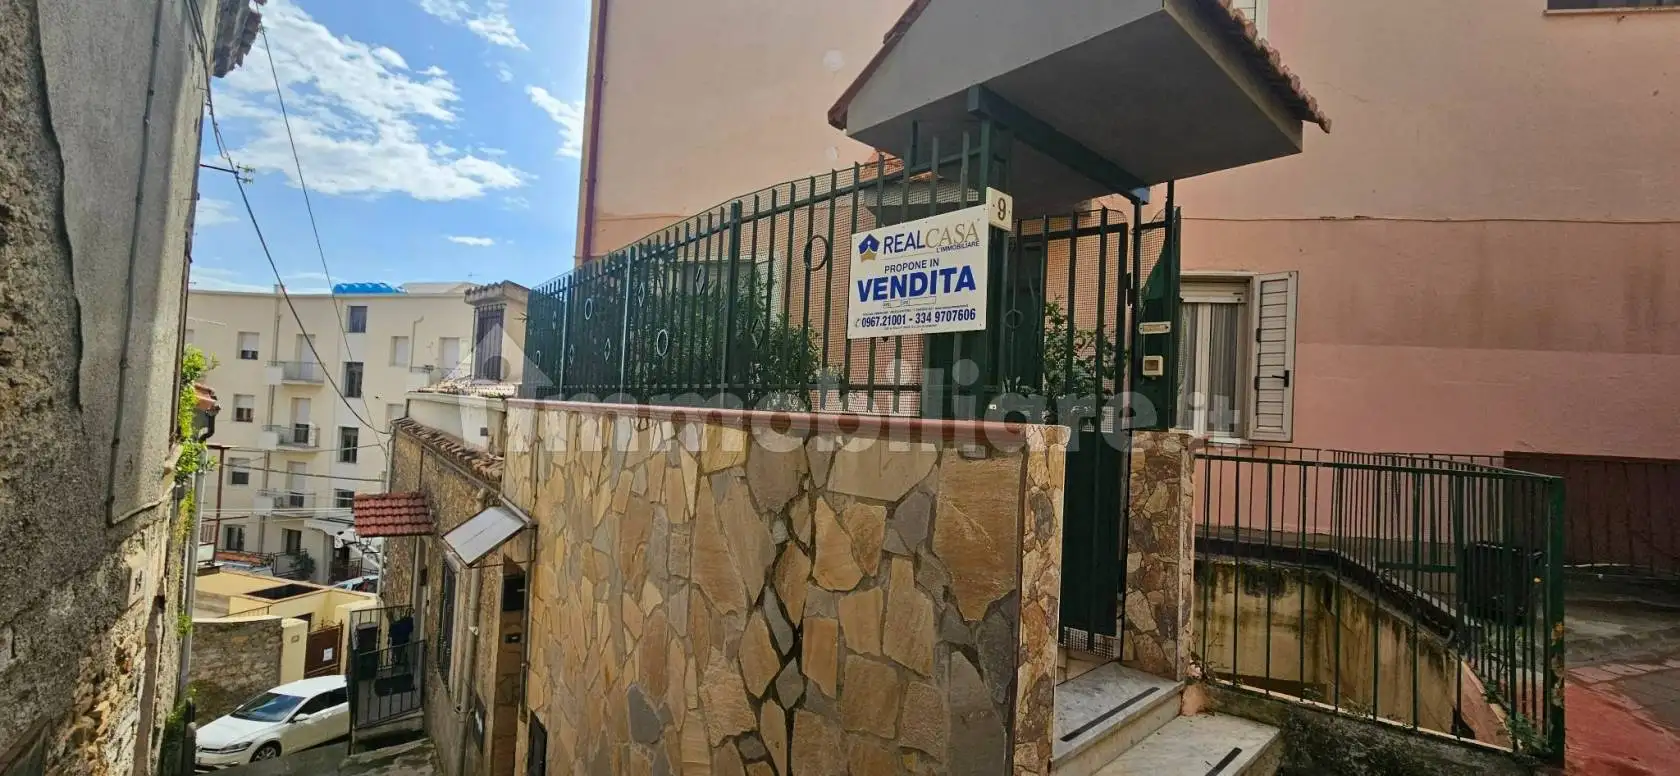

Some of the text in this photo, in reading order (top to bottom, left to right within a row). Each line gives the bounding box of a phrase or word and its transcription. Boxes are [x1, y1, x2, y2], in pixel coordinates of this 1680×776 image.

[997, 197, 1007, 221] 9
[884, 258, 940, 274] PROPONE IN
[857, 265, 977, 303] VENDITA
[861, 313, 906, 328] 0967.21001
[915, 312, 932, 324] 334
[934, 308, 976, 322] 9707606
